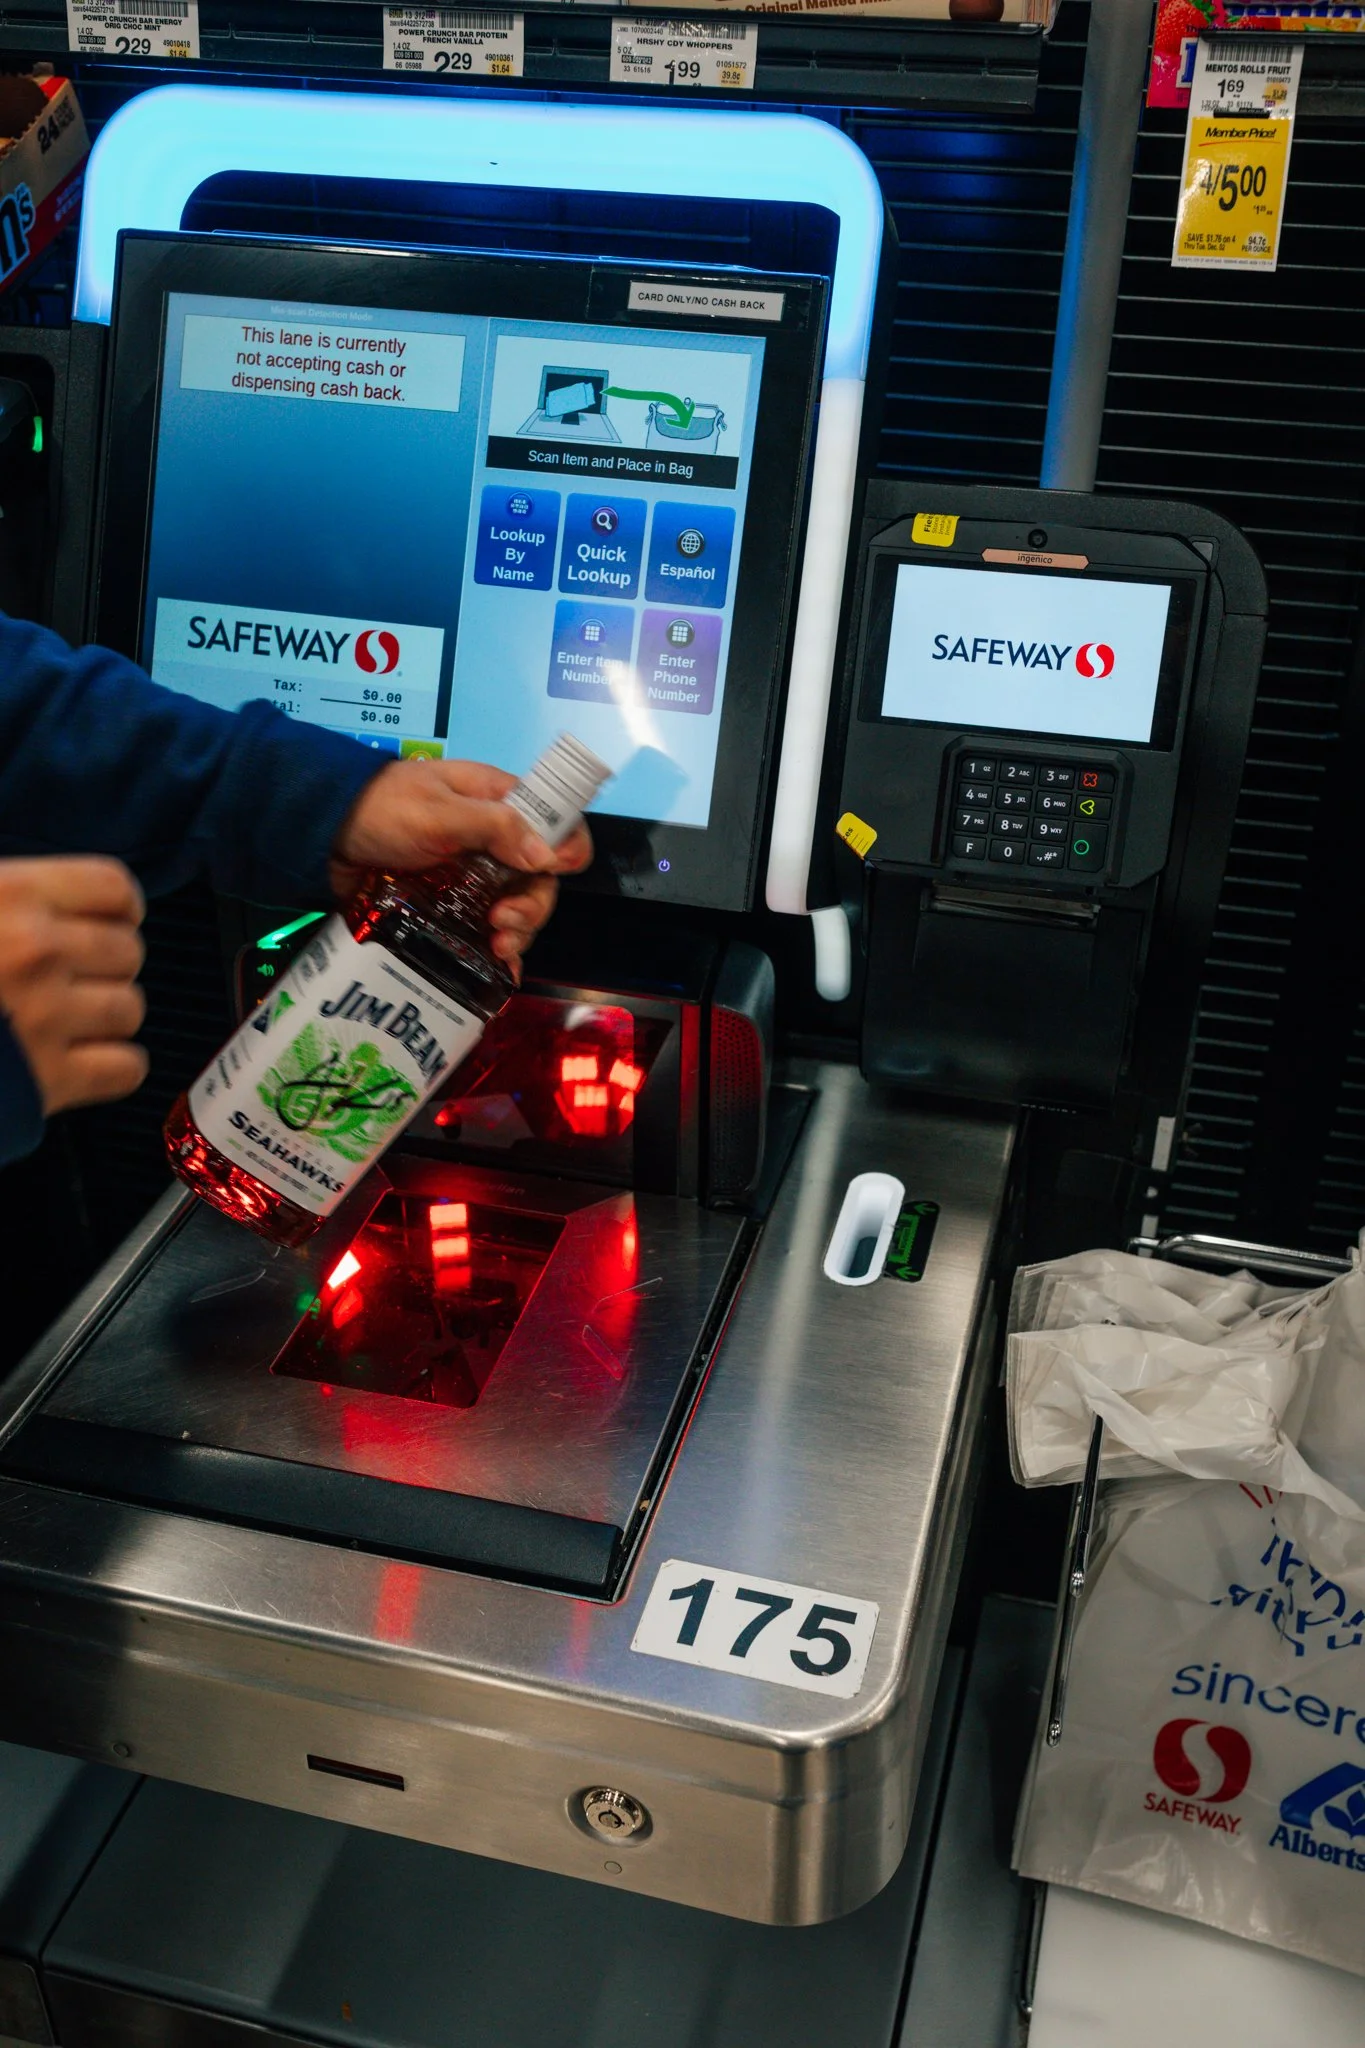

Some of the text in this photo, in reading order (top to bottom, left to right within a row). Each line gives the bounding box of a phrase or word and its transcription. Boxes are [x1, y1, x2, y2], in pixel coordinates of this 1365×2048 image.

[83, 14, 107, 22] POWER
[155, 18, 182, 26] ENERGY
[398, 28, 425, 36] POWER
[392, 42, 410, 50] 1.4 OZ
[622, 46, 632, 54] OZ
[636, 38, 733, 50] HRSHY CDY WHOPPERS
[492, 63, 510, 74] $1.64
[1205, 64, 1292, 74] MENTOS ROLLS FRUIT
[38, 114, 60, 154] 24
[1205, 128, 1277, 138] Member Price!
[1187, 233, 1204, 242] SAVE
[1184, 242, 1194, 250] Thru
[1253, 246, 1271, 254] OUNCE
[638, 292, 766, 310] CARD ONLY/NO CASH BACK
[242, 326, 406, 358] This lane is currently
[236, 350, 406, 378] not accepting cash or
[232, 372, 406, 402] dispensing cash back.
[528, 450, 694, 479] Scan Item and Place in Bag
[490, 526, 545, 546] Lookup
[505, 548, 526, 564] By
[576, 543, 626, 563] Quick
[1017, 554, 1053, 566] ingenico
[492, 566, 535, 582] Name
[567, 565, 631, 589] Lookup
[660, 564, 716, 580] Español
[187, 616, 350, 664] SAFEWAY
[556, 651, 593, 667] Enter
[932, 634, 1073, 671] SAFEWAY
[659, 654, 696, 670] Enter
[562, 669, 616, 686] Number
[654, 671, 698, 687] Phone
[274, 678, 402, 704] Tax: $0.00
[648, 686, 700, 704] Number
[360, 710, 400, 726] $0.00
[970, 762, 976, 774] 1
[1008, 766, 1016, 778] 2
[1046, 770, 1054, 782] 3
[966, 788, 974, 800] 4
[1004, 793, 1026, 804] 5 JKL
[1043, 798, 1051, 808] 6
[962, 814, 984, 826] 7 PRS
[1000, 820, 1024, 830] 8 TUV
[1040, 824, 1048, 835] 9
[966, 842, 974, 853] F
[1004, 846, 1012, 858] 0
[320, 980, 390, 1032] JIM
[228, 1110, 345, 1193] SEAHAWKS
[668, 1578, 858, 1676] 175
[1144, 1792, 1242, 1834] SAFEWAY
